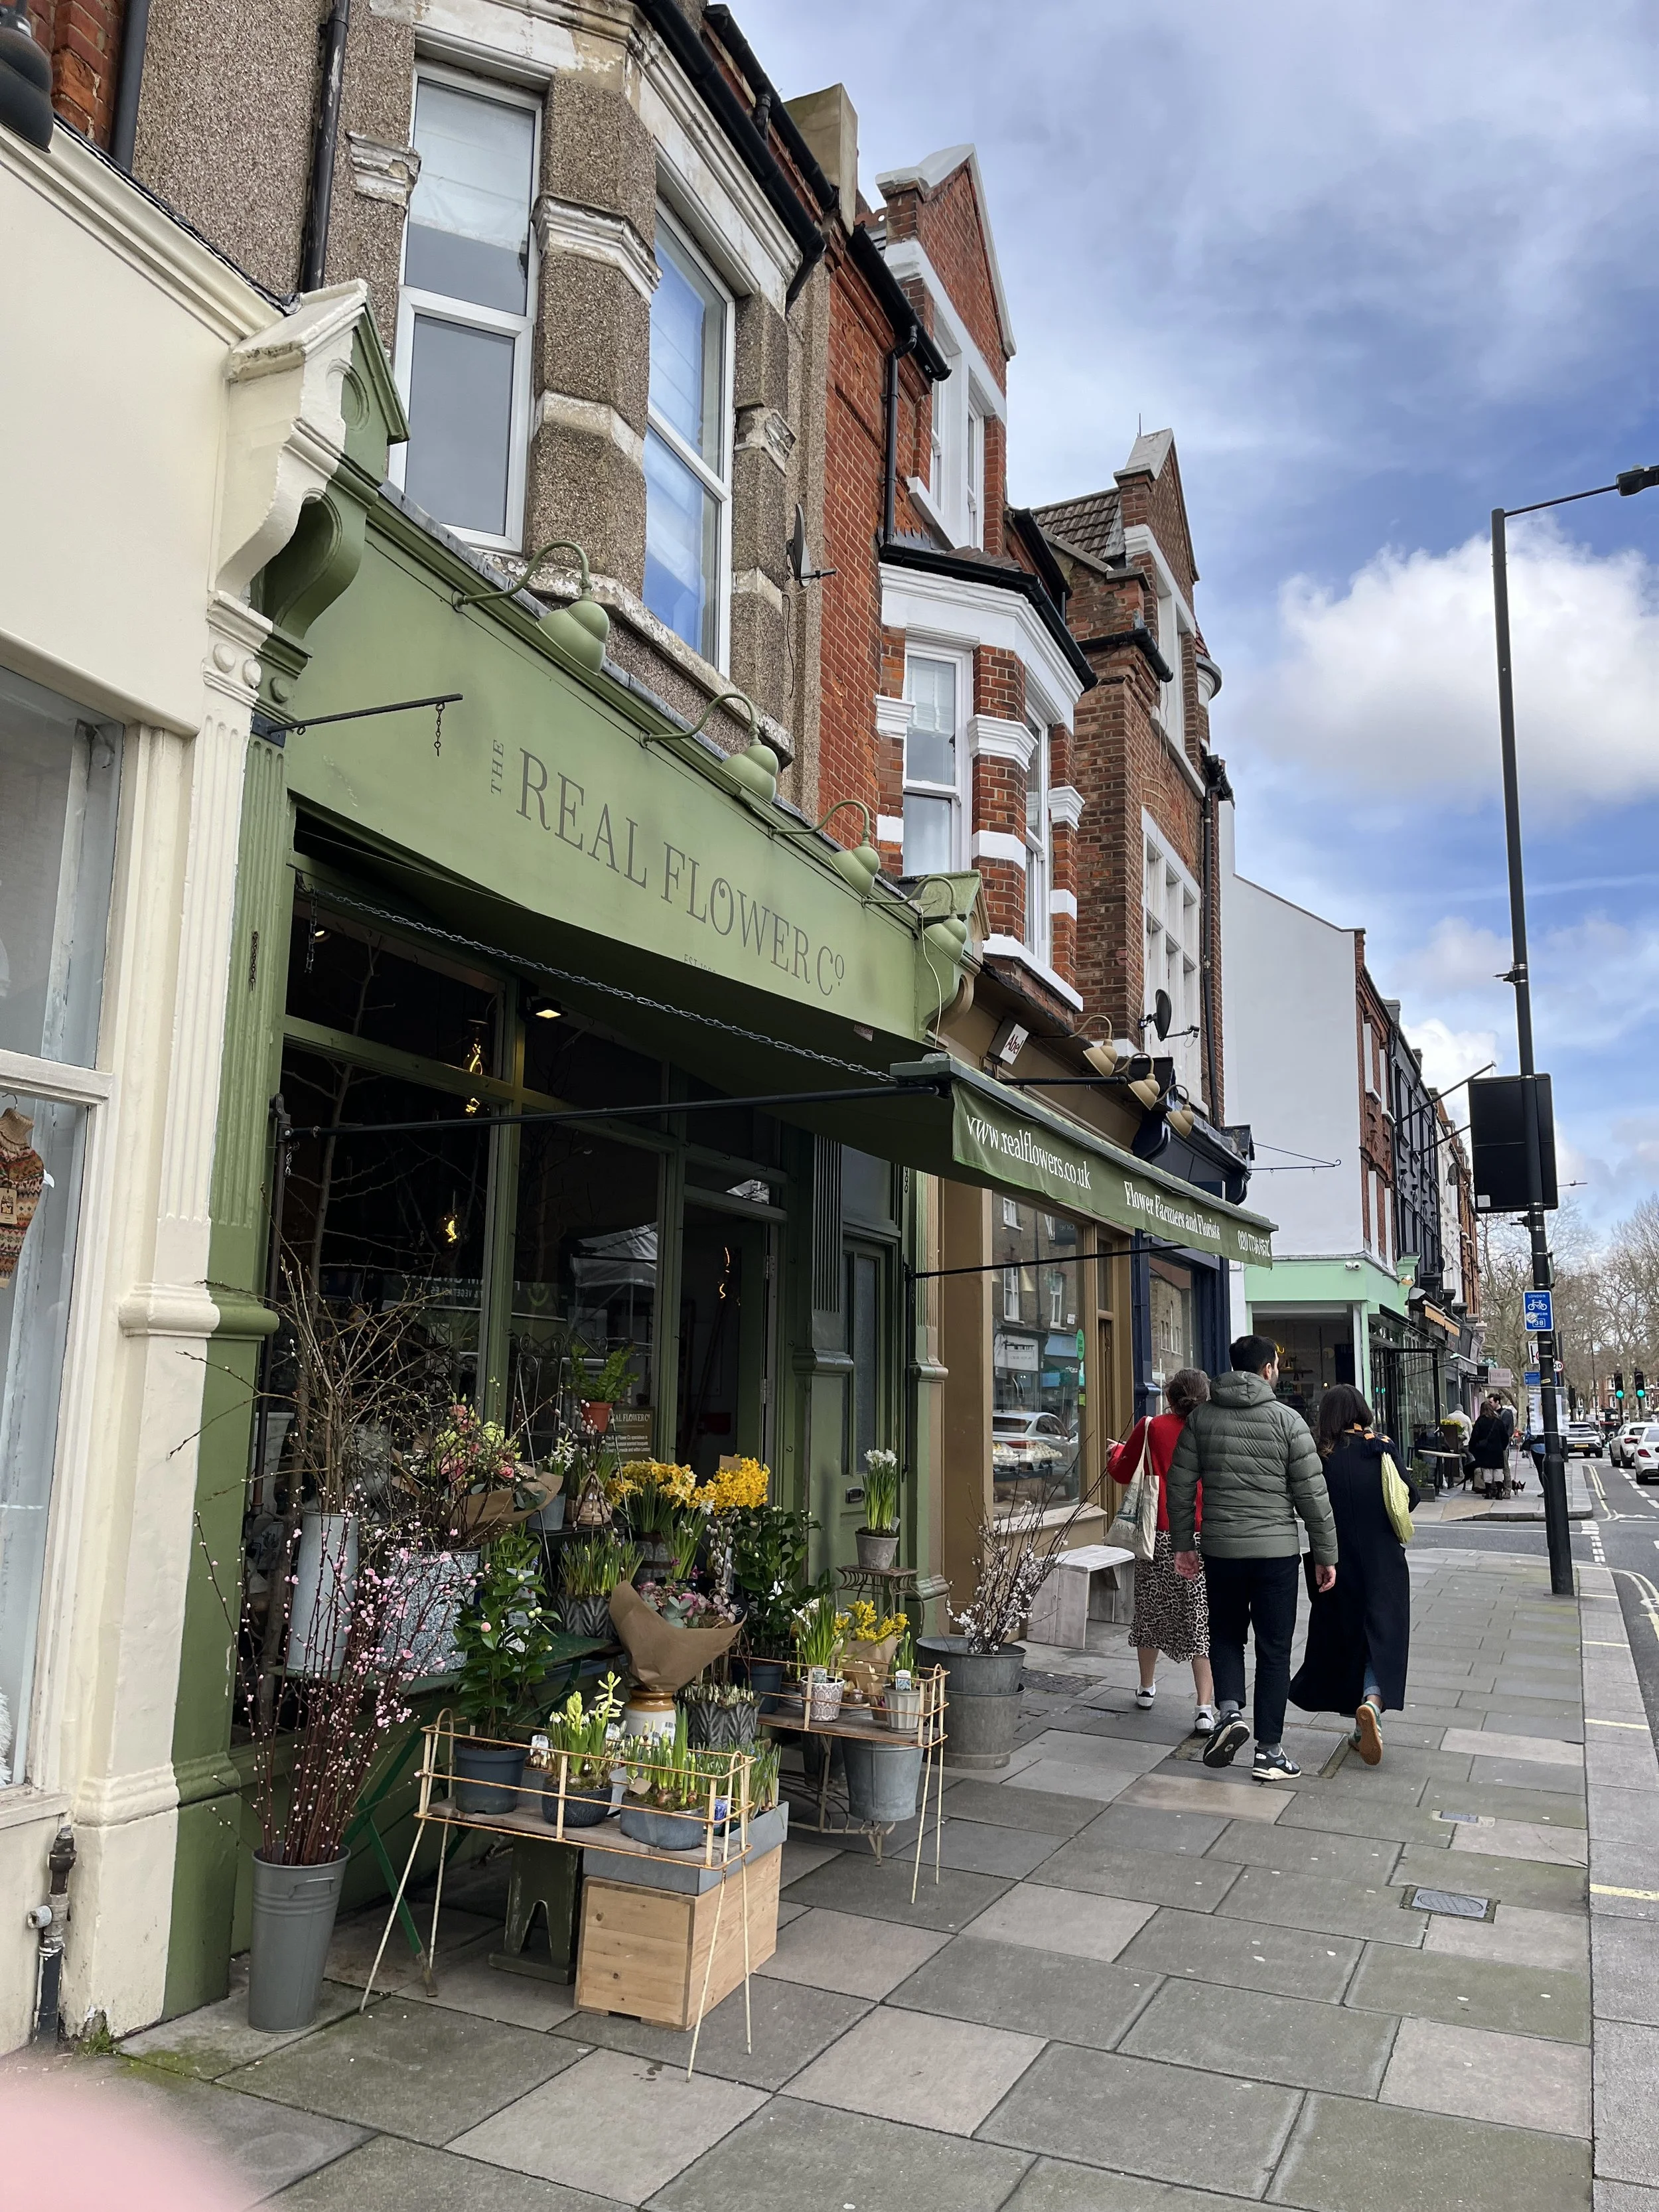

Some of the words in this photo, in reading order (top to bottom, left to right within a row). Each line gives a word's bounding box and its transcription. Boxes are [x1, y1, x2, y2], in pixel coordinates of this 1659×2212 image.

[490, 739, 504, 796] THE
[515, 747, 648, 889] REAL
[660, 841, 811, 984] FLOWER
[1005, 1034, 1025, 1055] Abel
[1123, 1181, 1155, 1215] Flower
[1155, 1194, 1185, 1228] Farmers
[1185, 1211, 1198, 1234] and
[1197, 1213, 1221, 1240] Florists
[623, 1413, 644, 1422] FLOWER
